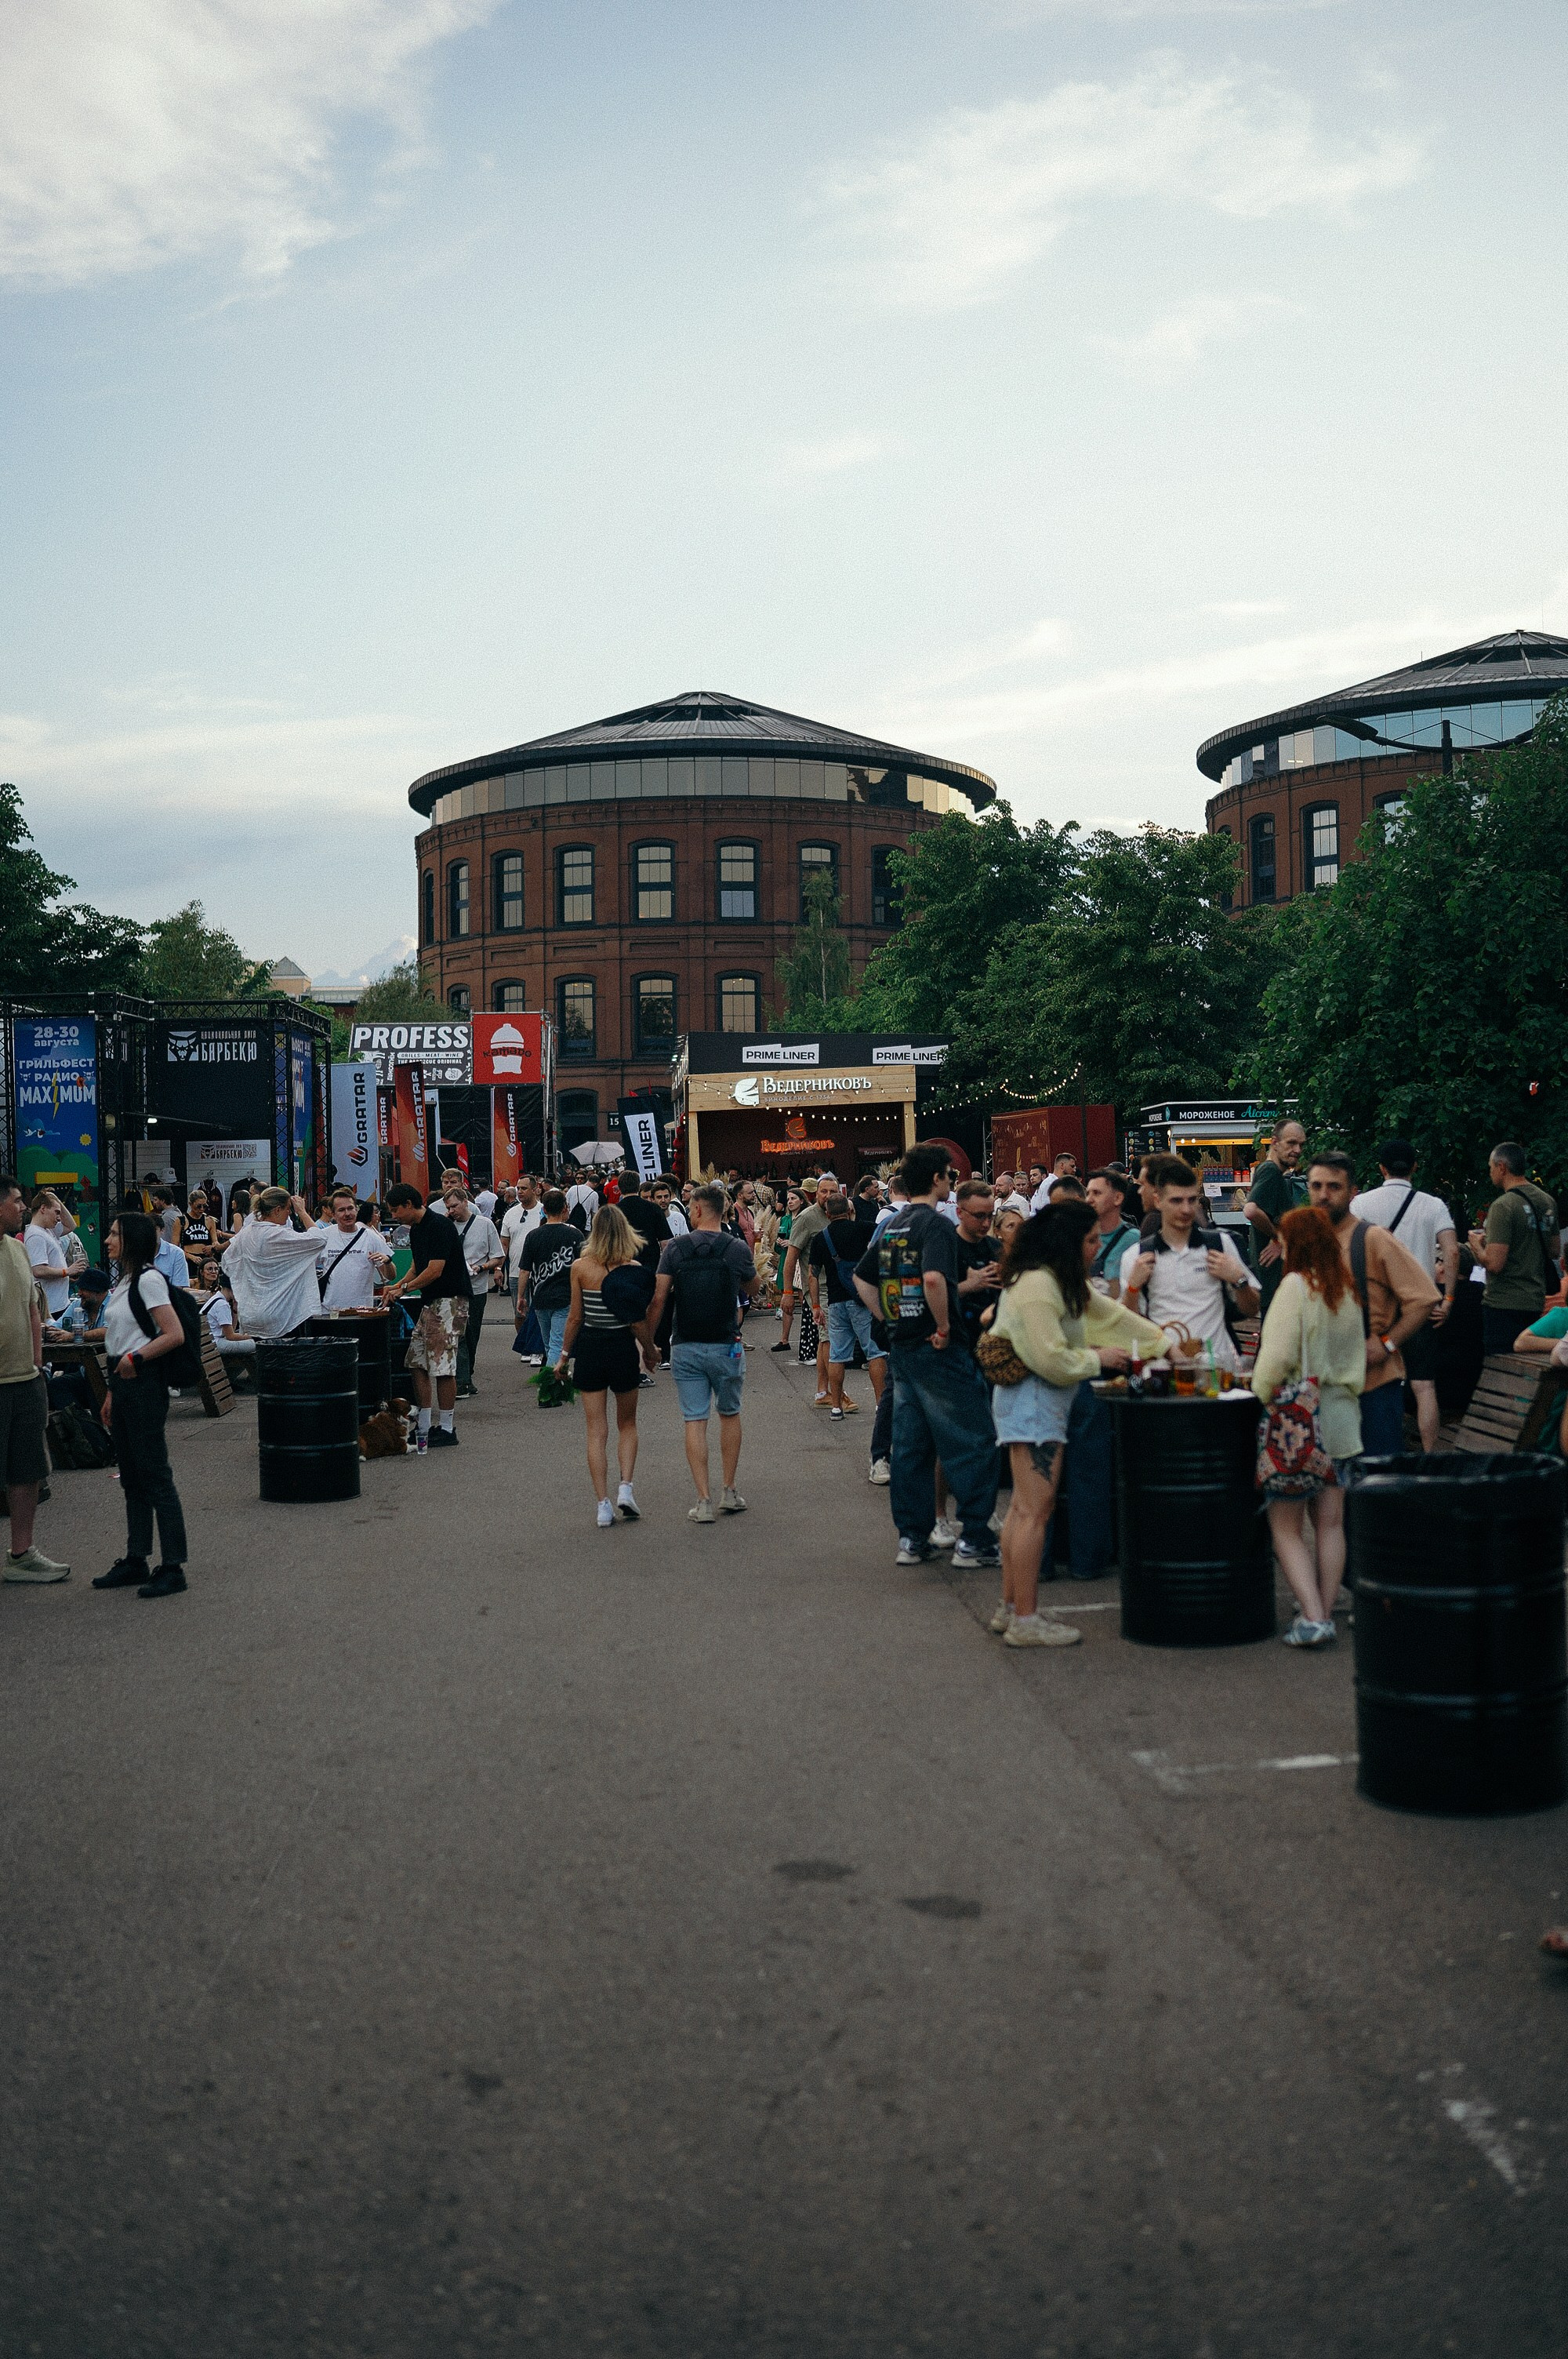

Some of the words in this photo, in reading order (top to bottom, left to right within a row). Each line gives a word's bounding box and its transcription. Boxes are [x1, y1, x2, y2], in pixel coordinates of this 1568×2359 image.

[34, 1026, 79, 1039] 28-30
[353, 1026, 469, 1049] PROFESS
[34, 1038, 79, 1049] августа
[201, 1041, 257, 1063] БАРБЕКЮ
[19, 1058, 95, 1070] ГРИЛЬФЕСТ
[746, 1051, 781, 1060] PRIME
[782, 1052, 815, 1060] LINER
[876, 1052, 911, 1060] PRIME
[913, 1052, 945, 1061] LINER
[34, 1071, 80, 1083] РАДИО
[353, 1071, 368, 1144] GRATAR
[411, 1070, 425, 1141] GRATAR
[379, 1096, 389, 1145] GRATAR
[507, 1093, 517, 1143] GRATAR
[1179, 1110, 1236, 1120] МОРОЖЕНОЕ
[637, 1119, 656, 1170] LINER
